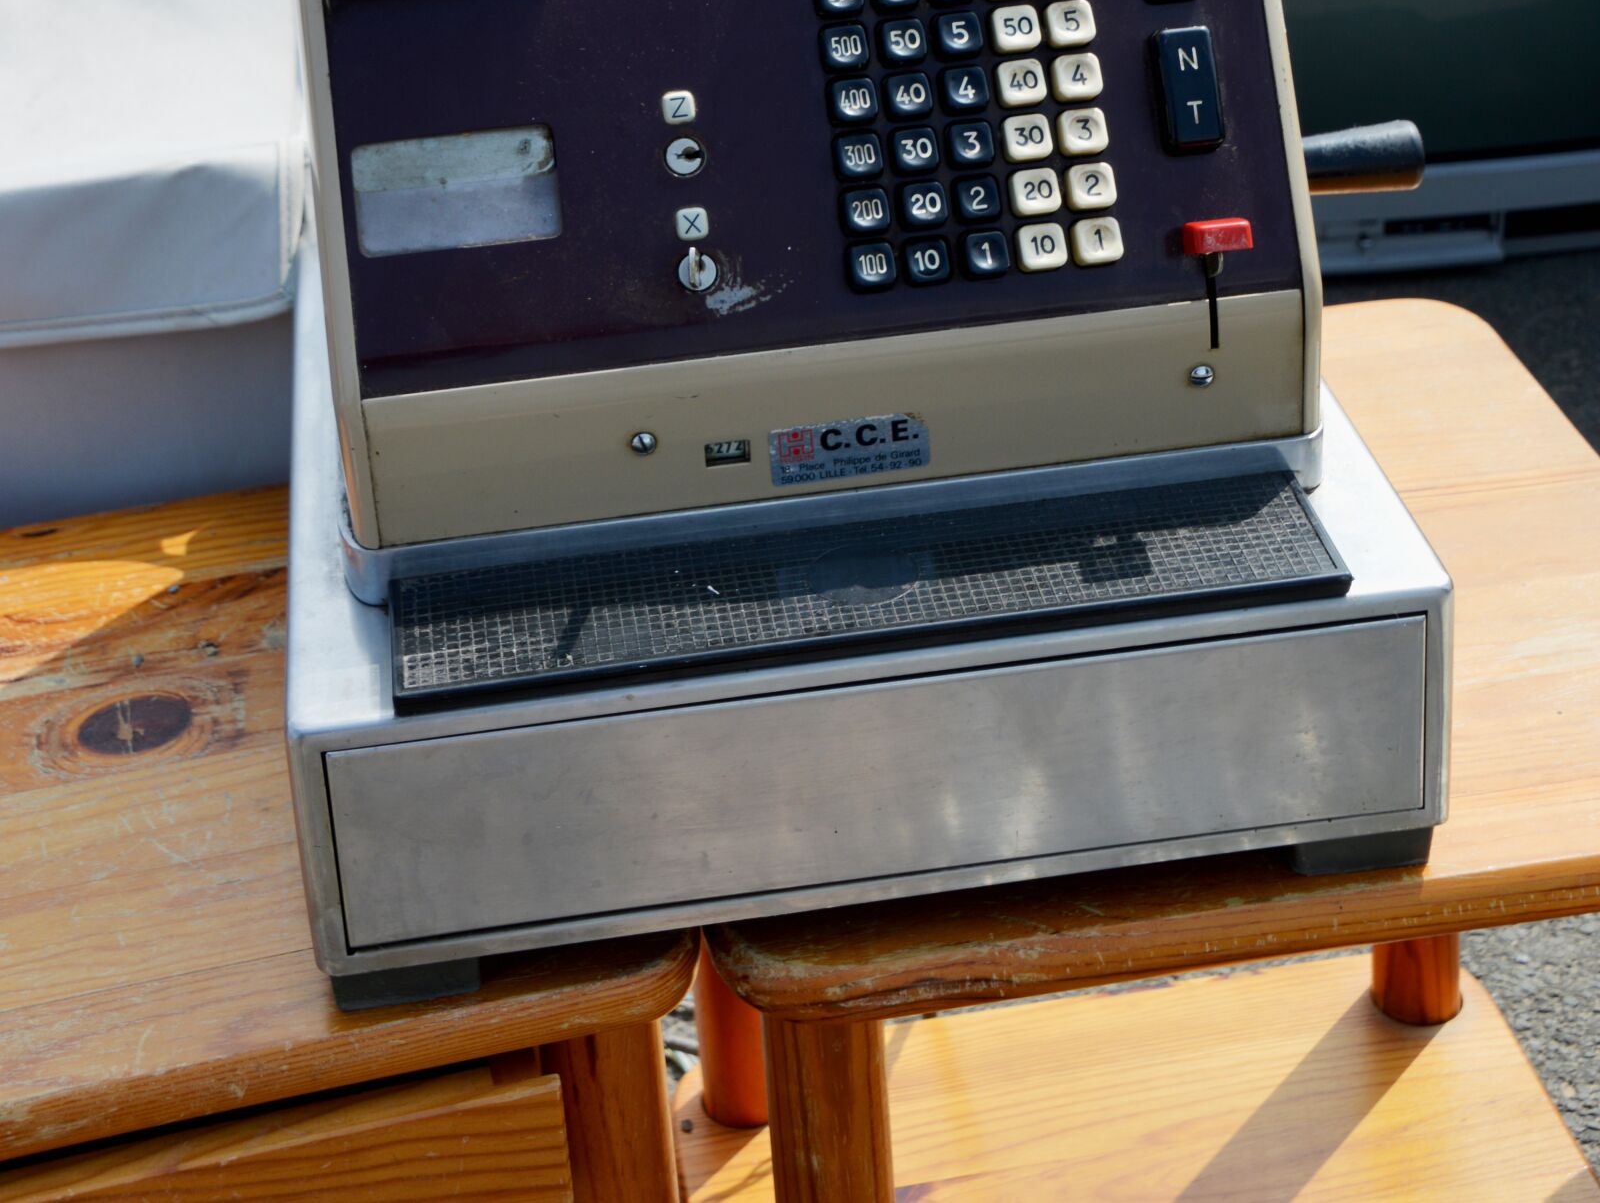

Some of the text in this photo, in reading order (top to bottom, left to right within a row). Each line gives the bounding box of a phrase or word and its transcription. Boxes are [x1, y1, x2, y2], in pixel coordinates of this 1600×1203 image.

[1003, 16, 1033, 36] 50
[1063, 10, 1080, 31] 5
[889, 28, 921, 49] 50
[951, 21, 970, 45] 5
[831, 35, 862, 57] 500
[1177, 46, 1200, 72] N
[1009, 70, 1038, 91] 40
[1071, 64, 1088, 86] 4
[840, 87, 871, 110] 400
[895, 83, 927, 105] 40
[957, 76, 976, 100] 4
[669, 97, 689, 119] Z
[1186, 99, 1203, 125] T
[1014, 125, 1044, 146] 30
[1075, 118, 1093, 141] 3
[844, 143, 876, 165] 300
[901, 138, 933, 160] 30
[963, 131, 981, 155] 3
[1023, 179, 1053, 201] 20
[1085, 174, 1102, 197] 2
[852, 198, 883, 221] 200
[911, 192, 942, 214] 20
[970, 186, 988, 211] 2
[682, 213, 702, 235] X
[1030, 235, 1056, 256] 10
[1093, 228, 1105, 251] 1
[859, 253, 888, 276] 100
[914, 248, 940, 271] 10
[981, 242, 993, 265] 1
[820, 419, 919, 451] C.C.E.
[799, 462, 826, 472] Place
[833, 456, 871, 468] Philippe
[874, 453, 887, 461] de
[890, 448, 921, 459] Girard
[819, 469, 846, 479] LILLE
